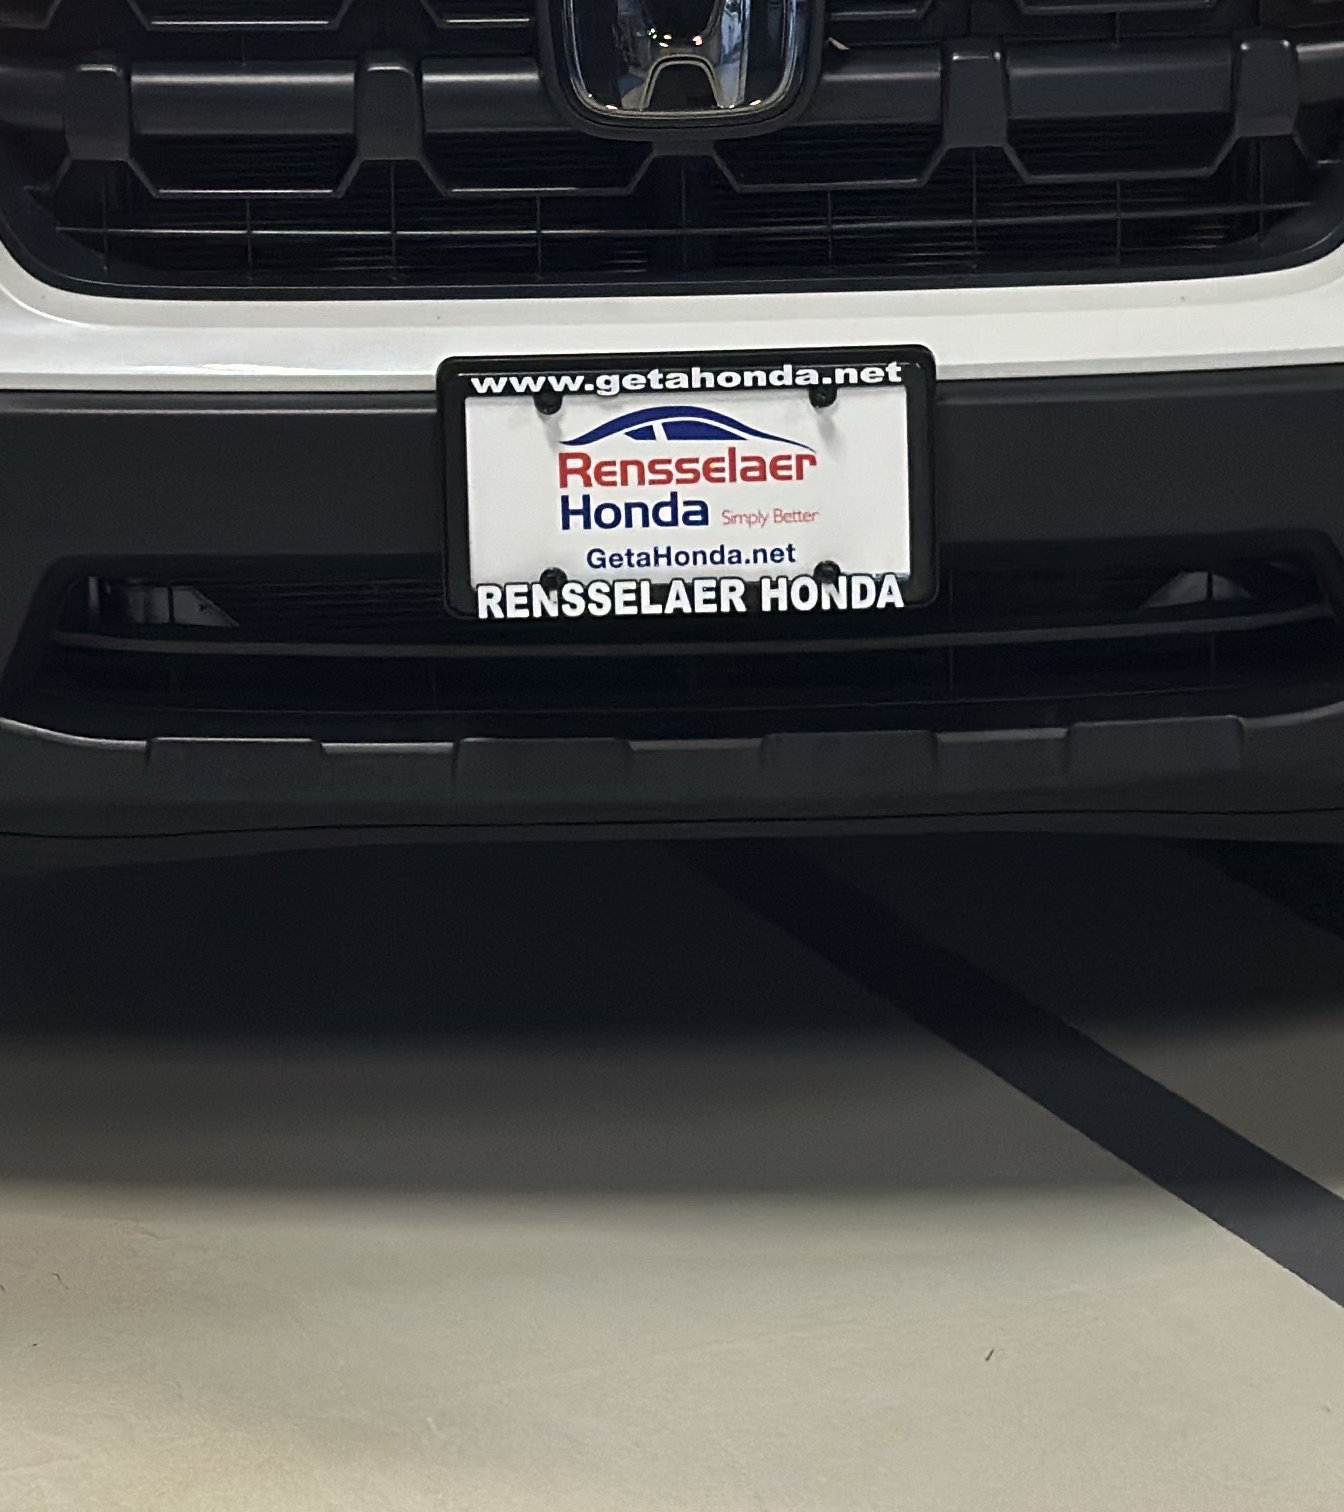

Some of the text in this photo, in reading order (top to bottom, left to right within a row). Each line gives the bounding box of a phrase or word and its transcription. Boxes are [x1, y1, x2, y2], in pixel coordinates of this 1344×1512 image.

[470, 361, 902, 396] www.getahonda.net
[558, 446, 818, 489] Rensselaer
[560, 491, 710, 531] Honda
[721, 507, 820, 528] Simply Better
[586, 543, 797, 569] GetaHonda.net
[476, 574, 905, 620] RENSSELAER HONDA
